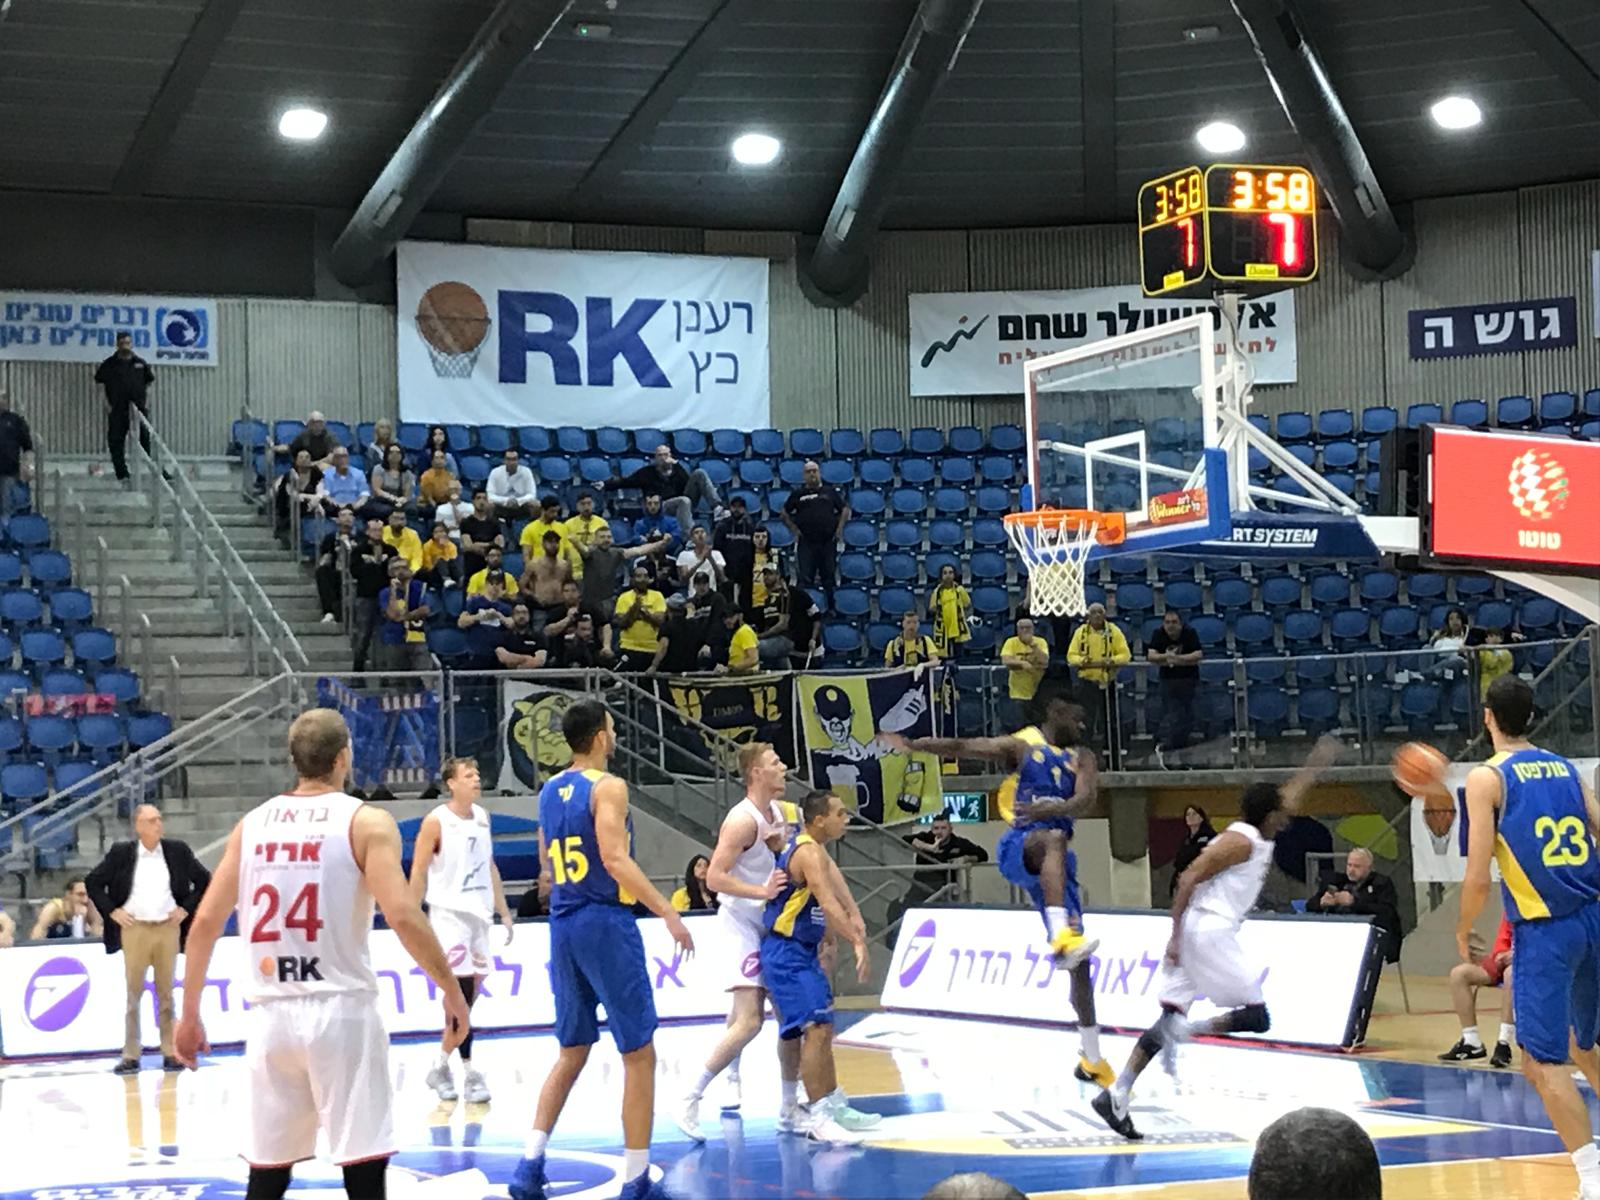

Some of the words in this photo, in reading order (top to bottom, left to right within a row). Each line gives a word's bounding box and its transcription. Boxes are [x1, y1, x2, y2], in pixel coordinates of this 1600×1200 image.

[1156, 174, 1201, 222] 3:58
[1233, 171, 1309, 209] 3:58
[1177, 217, 1194, 267] 7
[1268, 213, 1296, 266] 7
[6, 302, 73, 322] טובים
[81, 304, 149, 325] דברים
[672, 300, 753, 342] רענן
[998, 312, 1087, 341] שחם
[1474, 307, 1561, 345] גוש
[50, 323, 150, 347] מחילים
[498, 289, 672, 388] RK
[1424, 316, 1454, 349] ה
[688, 351, 739, 393] כץ
[1518, 530, 1561, 549] טוטו
[264, 807, 329, 827] בראון
[1535, 815, 1589, 867] 23
[548, 836, 589, 885] 15
[251, 882, 323, 943] 24
[277, 956, 324, 982] RK
